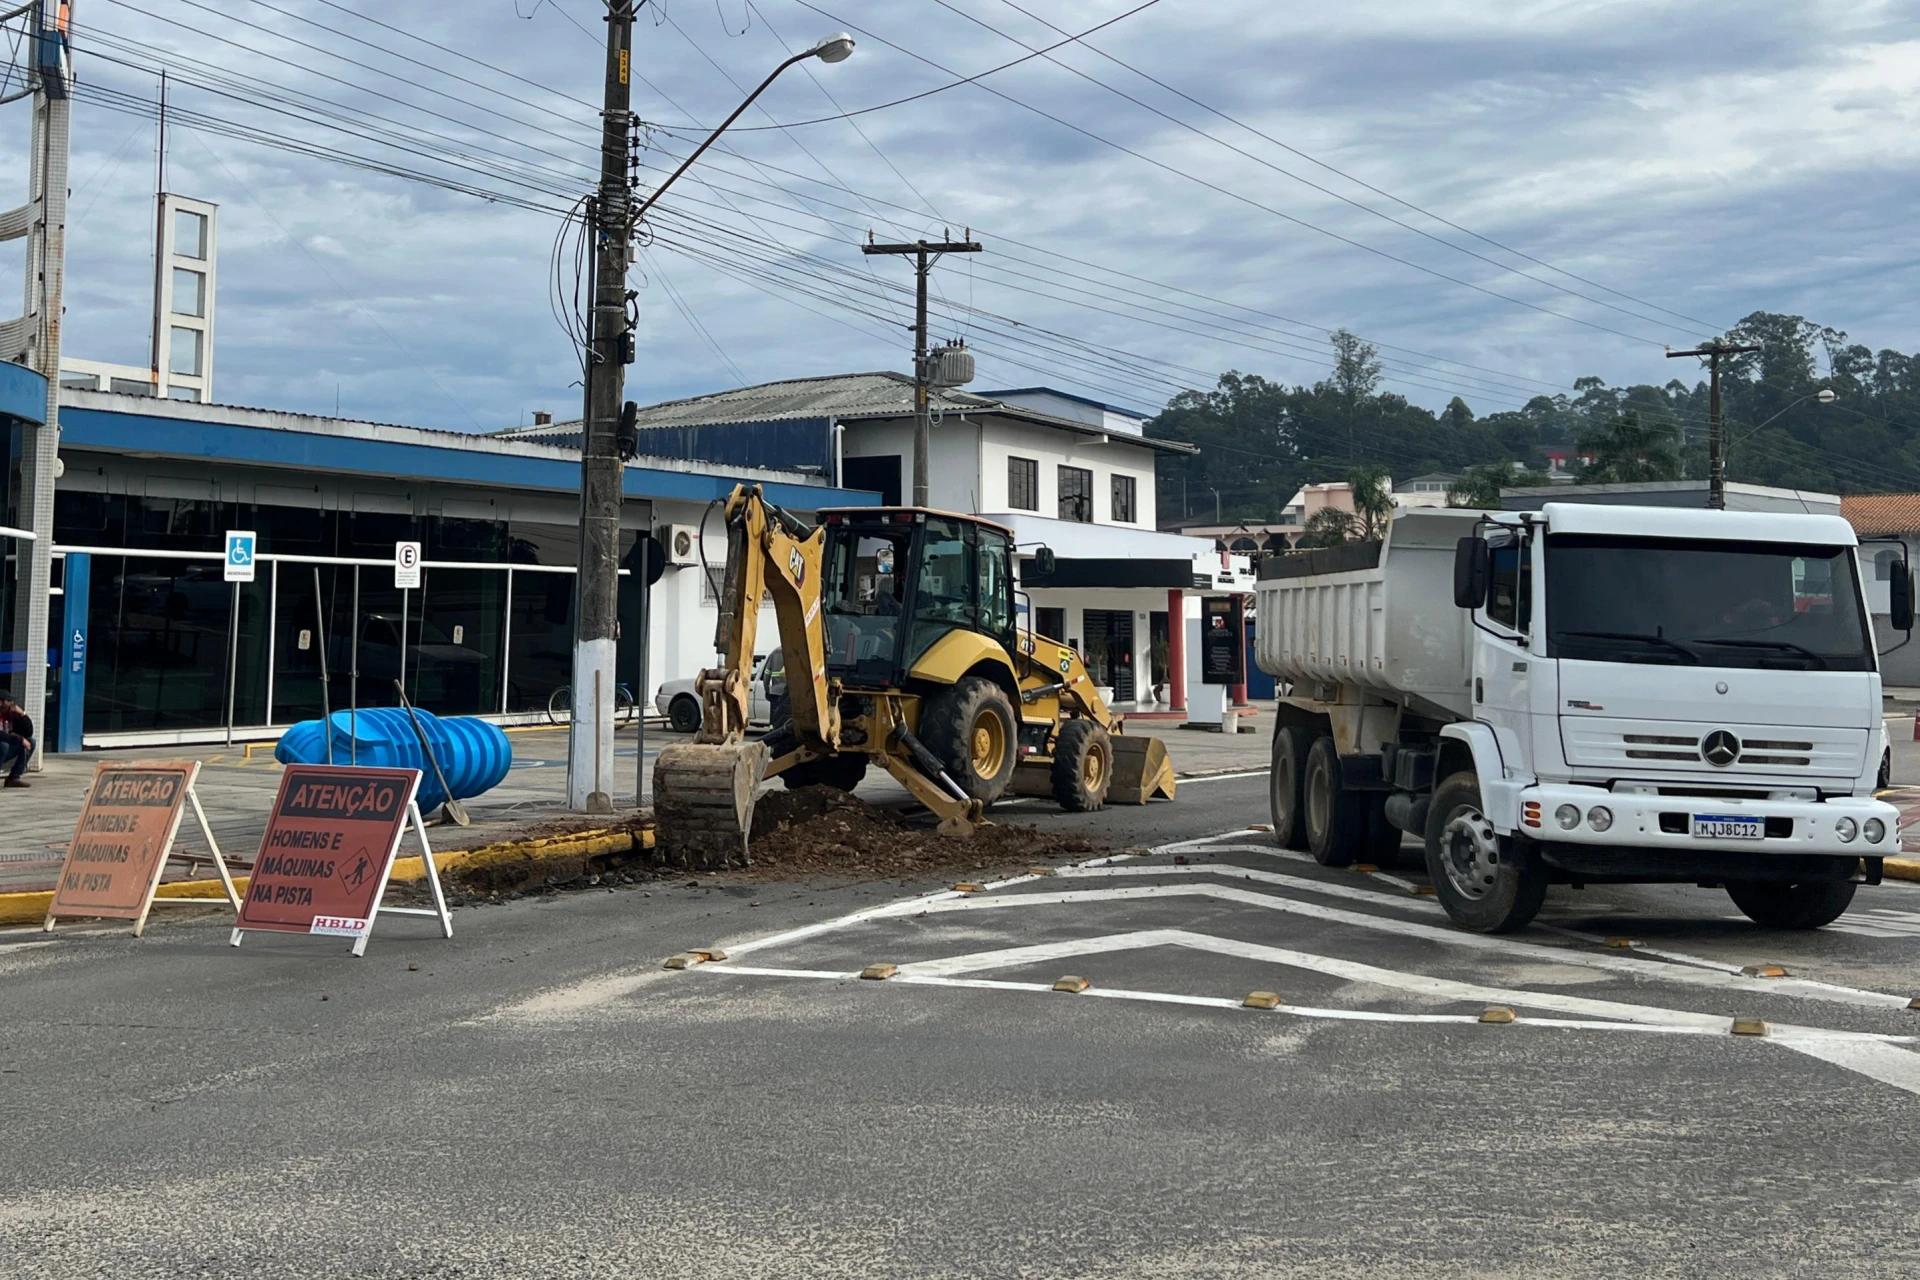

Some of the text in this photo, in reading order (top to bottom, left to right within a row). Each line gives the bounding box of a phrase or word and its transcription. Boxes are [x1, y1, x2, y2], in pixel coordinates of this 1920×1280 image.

[405, 550, 412, 563] E
[789, 545, 804, 580] CAT
[100, 777, 174, 803] ATENÇÃO
[291, 783, 394, 816] ATENÇÃO
[83, 814, 139, 832] HOMENS E
[1701, 823, 1757, 836] MJJ8C12
[270, 830, 343, 850] HOMENS E
[75, 839, 130, 863] MÁQUINAS
[261, 854, 335, 878] MÁQUINAS
[65, 873, 112, 891] NA PISTA
[252, 884, 312, 905] NA PISTA
[315, 918, 365, 929] HBLD
